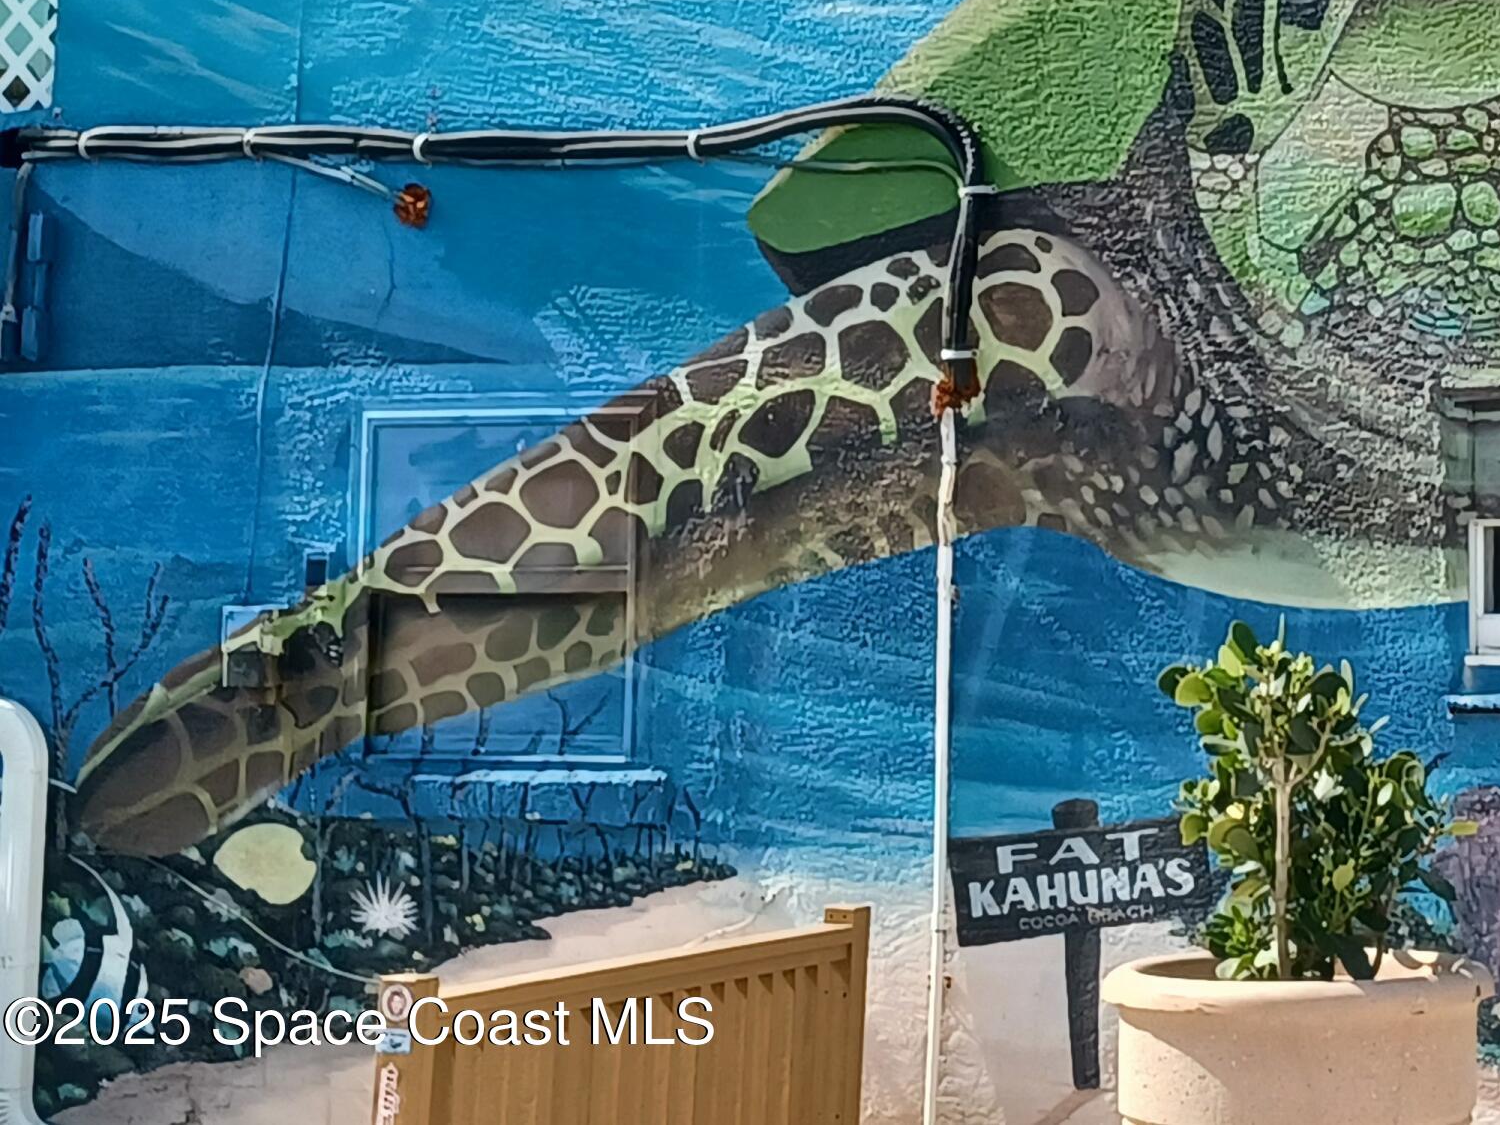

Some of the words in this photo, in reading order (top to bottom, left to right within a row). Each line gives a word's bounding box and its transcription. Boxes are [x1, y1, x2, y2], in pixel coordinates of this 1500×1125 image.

[995, 827, 1160, 875] FAT
[967, 856, 1196, 919] KAHUNA'S
[1018, 913, 1079, 931] COCOA
